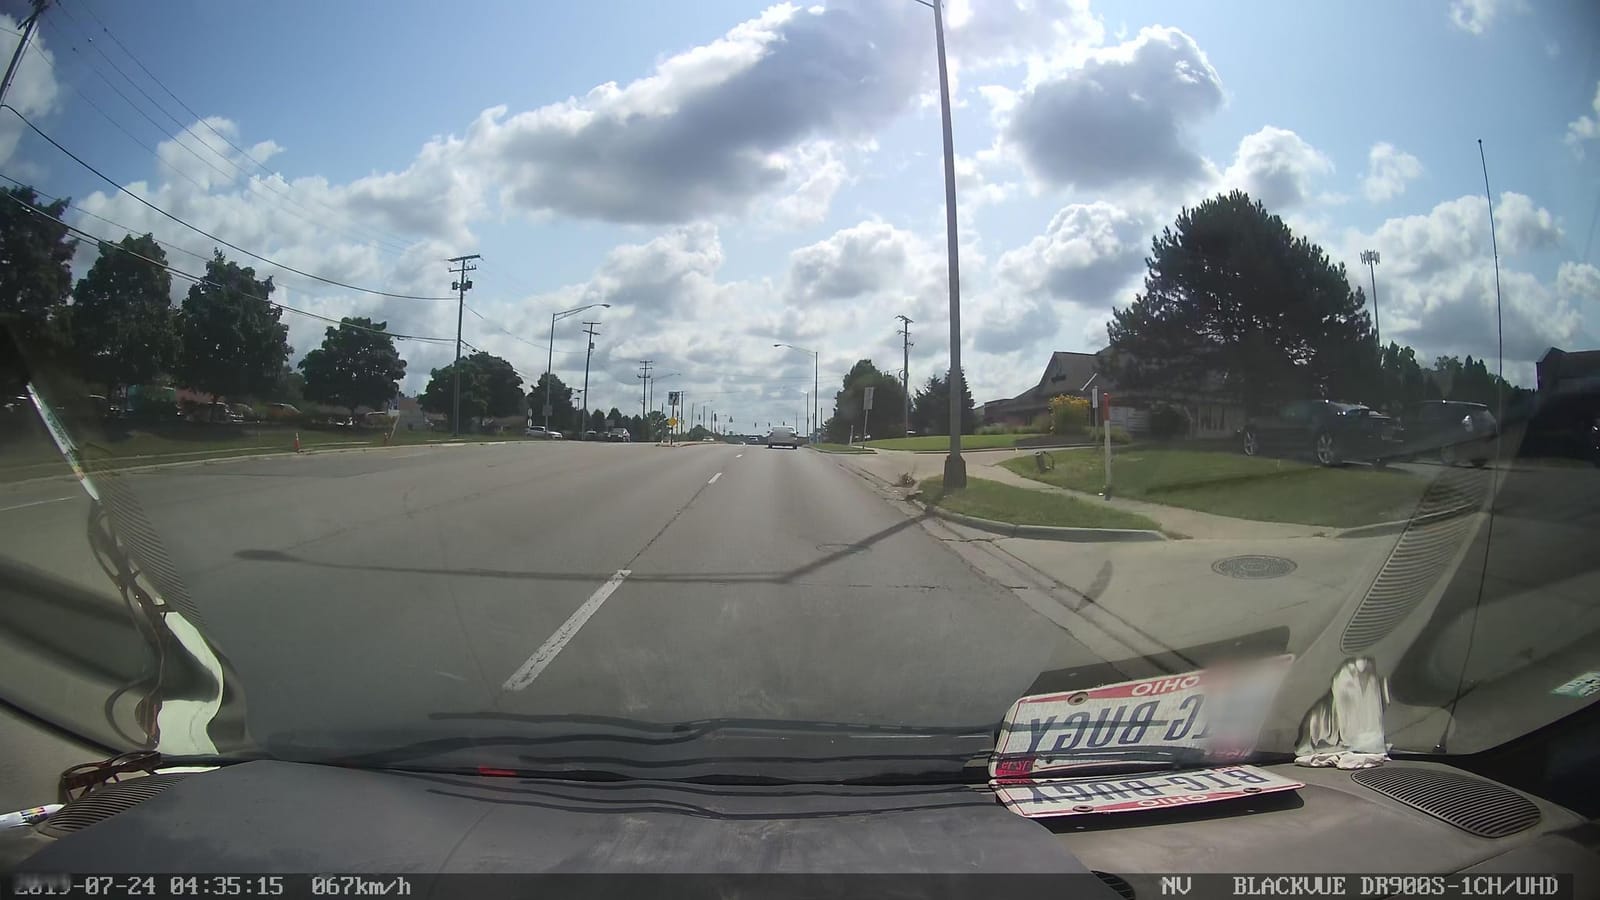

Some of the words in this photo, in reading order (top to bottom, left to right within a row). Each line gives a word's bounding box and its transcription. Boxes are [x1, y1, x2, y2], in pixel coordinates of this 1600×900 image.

[1031, 779, 1163, 804] BUGY
[1165, 770, 1269, 793] BIG
[1138, 793, 1207, 807] OHIO
